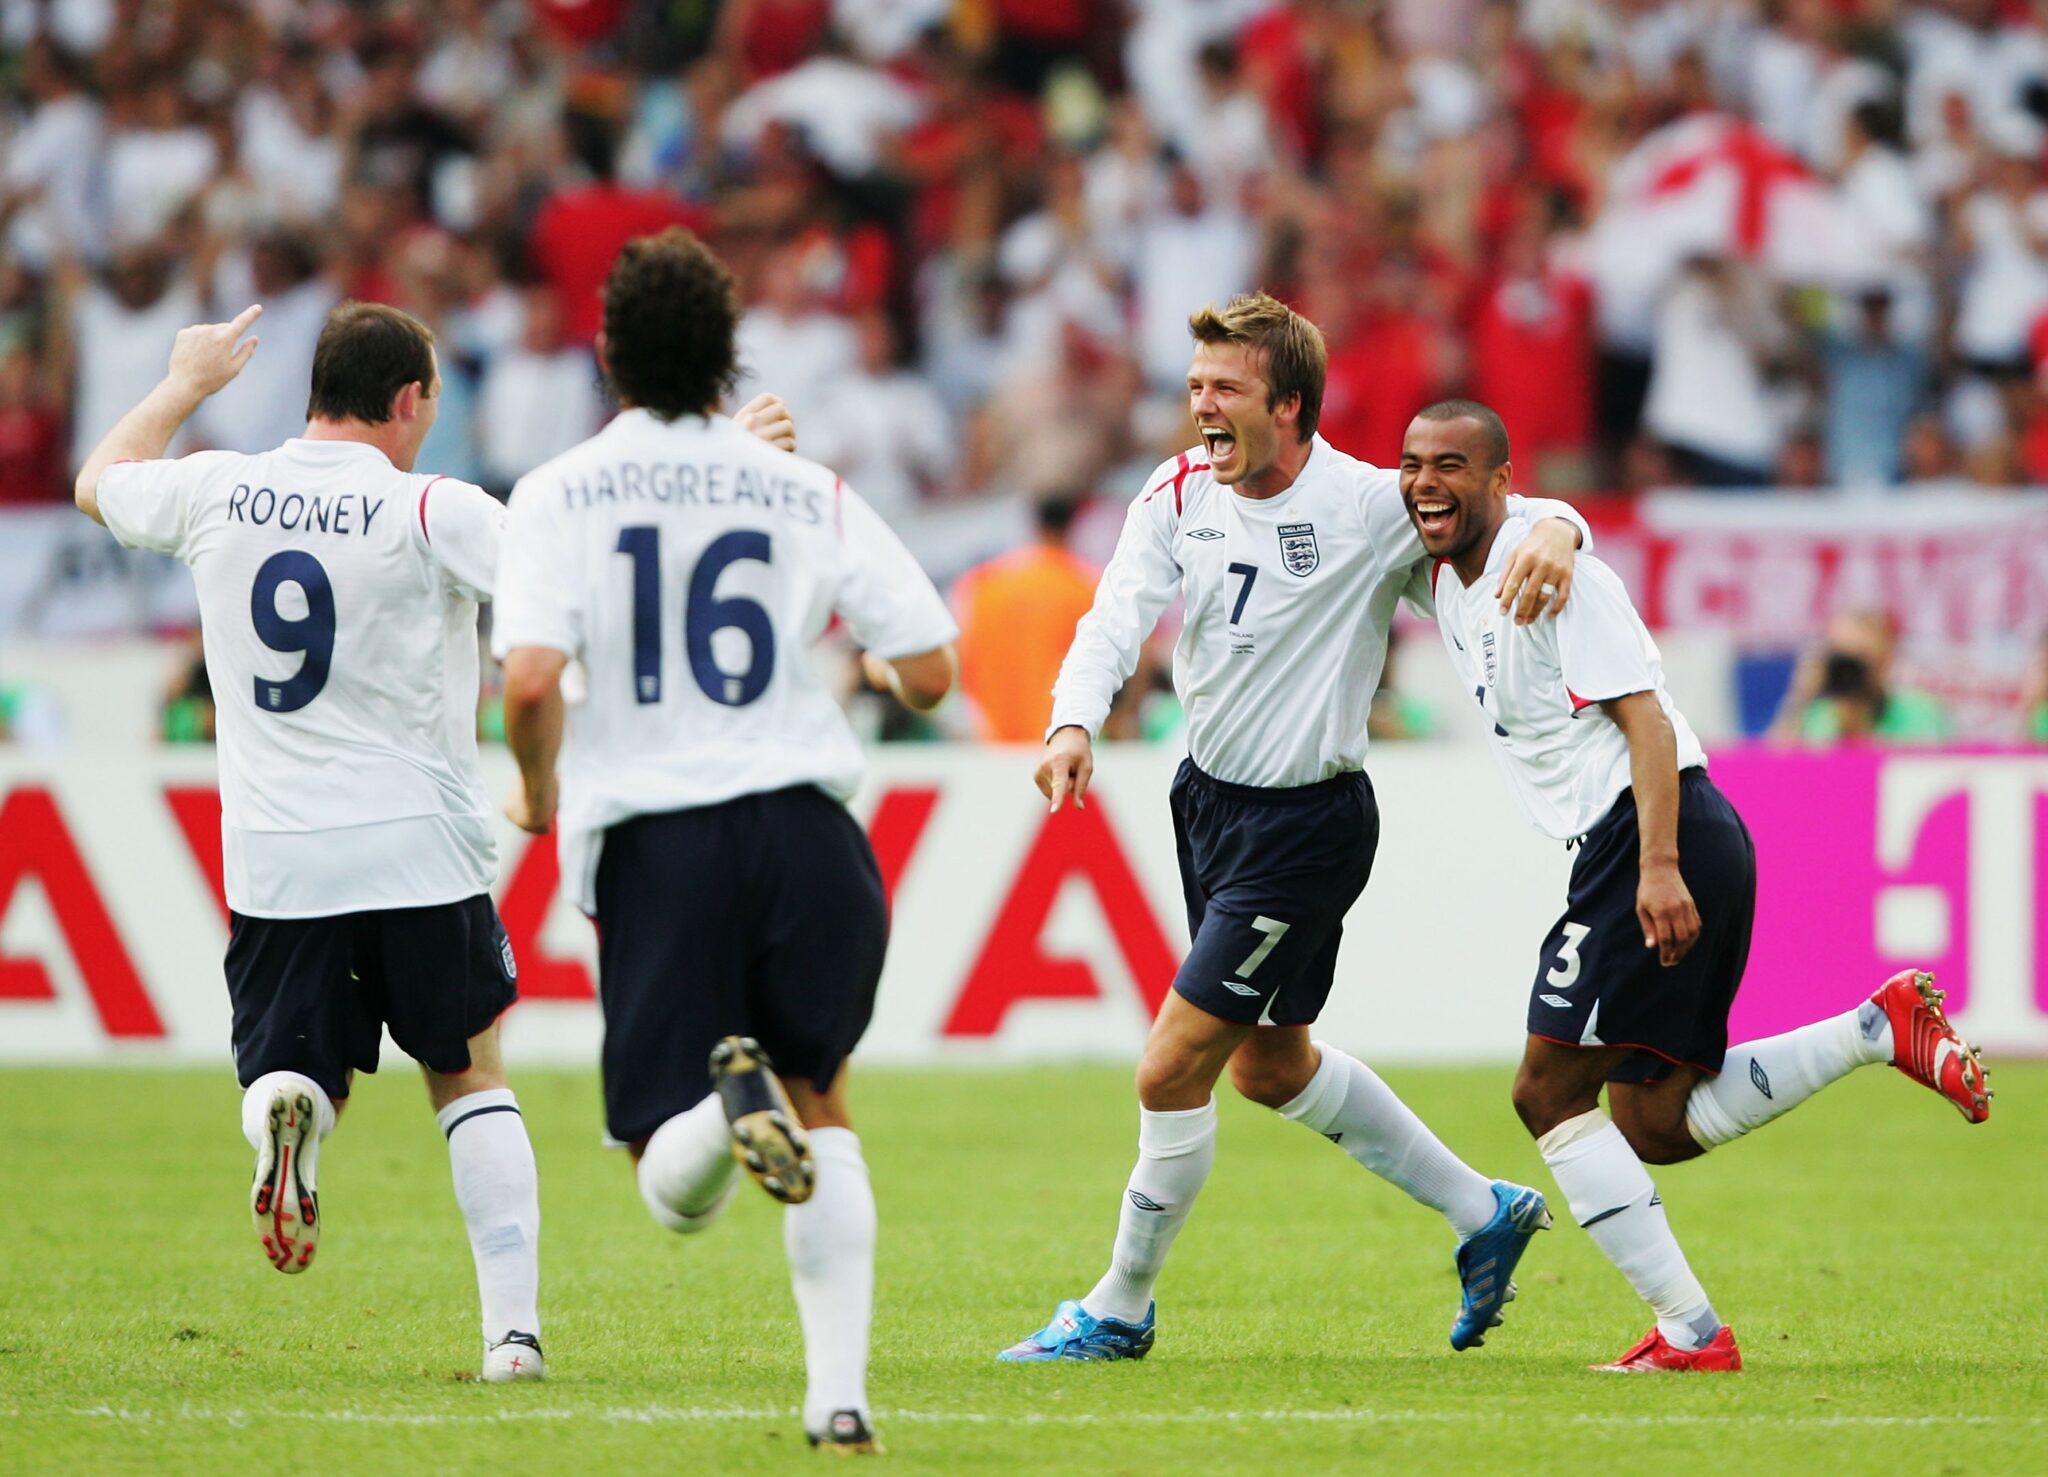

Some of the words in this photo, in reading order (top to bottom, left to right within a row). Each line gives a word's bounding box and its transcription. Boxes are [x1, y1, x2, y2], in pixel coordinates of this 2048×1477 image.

[227, 484, 384, 536] ROONEY
[562, 462, 822, 525] HARGREAVES
[616, 525, 776, 708] 16
[1229, 562, 1258, 625] 7
[250, 548, 337, 713] 9
[1234, 914, 1291, 978] 7
[1546, 921, 1591, 988] 3
